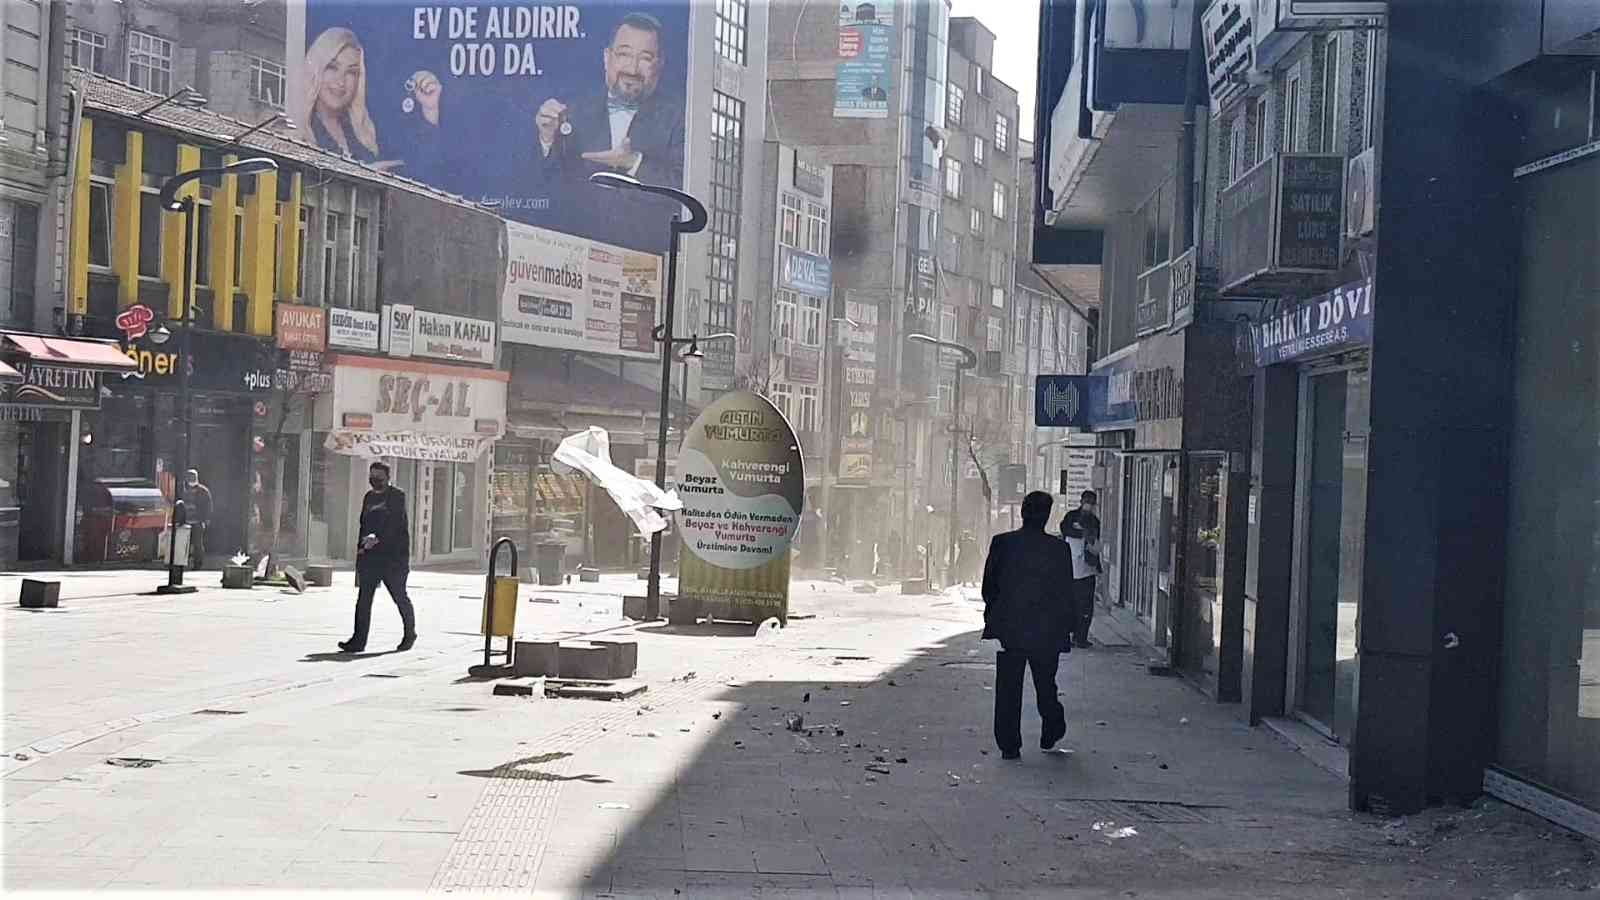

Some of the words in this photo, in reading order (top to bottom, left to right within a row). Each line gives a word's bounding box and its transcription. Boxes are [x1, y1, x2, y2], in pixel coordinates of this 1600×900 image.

[413, 7, 442, 39] EV
[448, 7, 477, 39] DE
[485, 5, 586, 39] ALDIRIR.
[450, 43, 496, 76] OTO
[504, 42, 543, 76] DA.
[509, 256, 583, 289] güvenmatbaa
[281, 311, 321, 329] AVUKAT
[1261, 304, 1312, 349] BİRİKİM
[1317, 276, 1372, 331] DÖVİ
[418, 316, 451, 337] Hakan
[123, 344, 177, 375] öner
[375, 374, 472, 423] SEÇ-AL
[719, 409, 764, 425] ALTIN
[703, 424, 784, 442] YUMURTA
[720, 459, 790, 474] Kahverengi
[684, 473, 718, 485] Beyaz
[729, 471, 781, 484] Yumurta
[677, 483, 725, 495] Yumurta
[723, 508, 748, 521] Ödün
[685, 518, 714, 531] Beyaz
[717, 522, 729, 530] ve
[732, 521, 788, 537] Kahverengi
[714, 530, 757, 542] Yumurta
